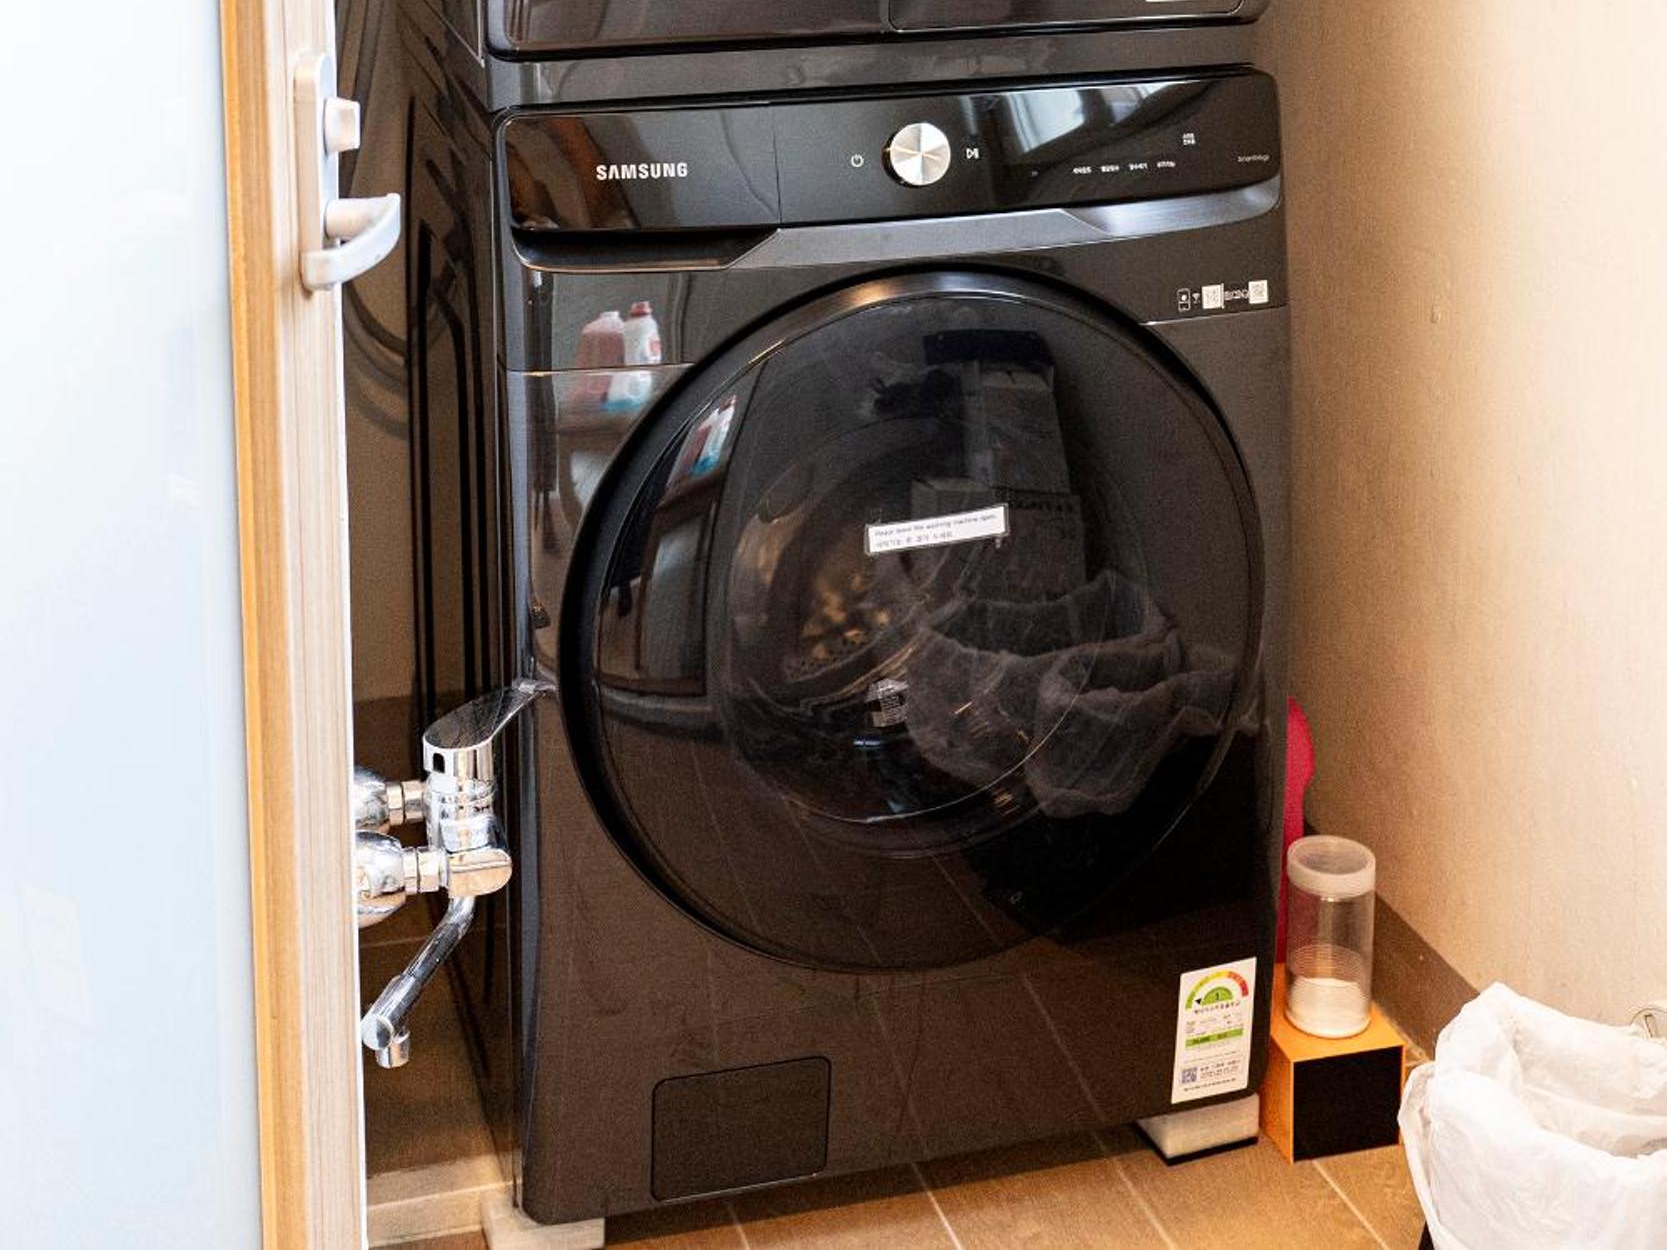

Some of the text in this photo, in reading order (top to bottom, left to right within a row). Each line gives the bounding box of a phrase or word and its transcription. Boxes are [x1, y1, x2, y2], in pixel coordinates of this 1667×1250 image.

[596, 162, 688, 181] SAMSUNG
[926, 520, 951, 530] washing
[953, 517, 978, 526] machine
